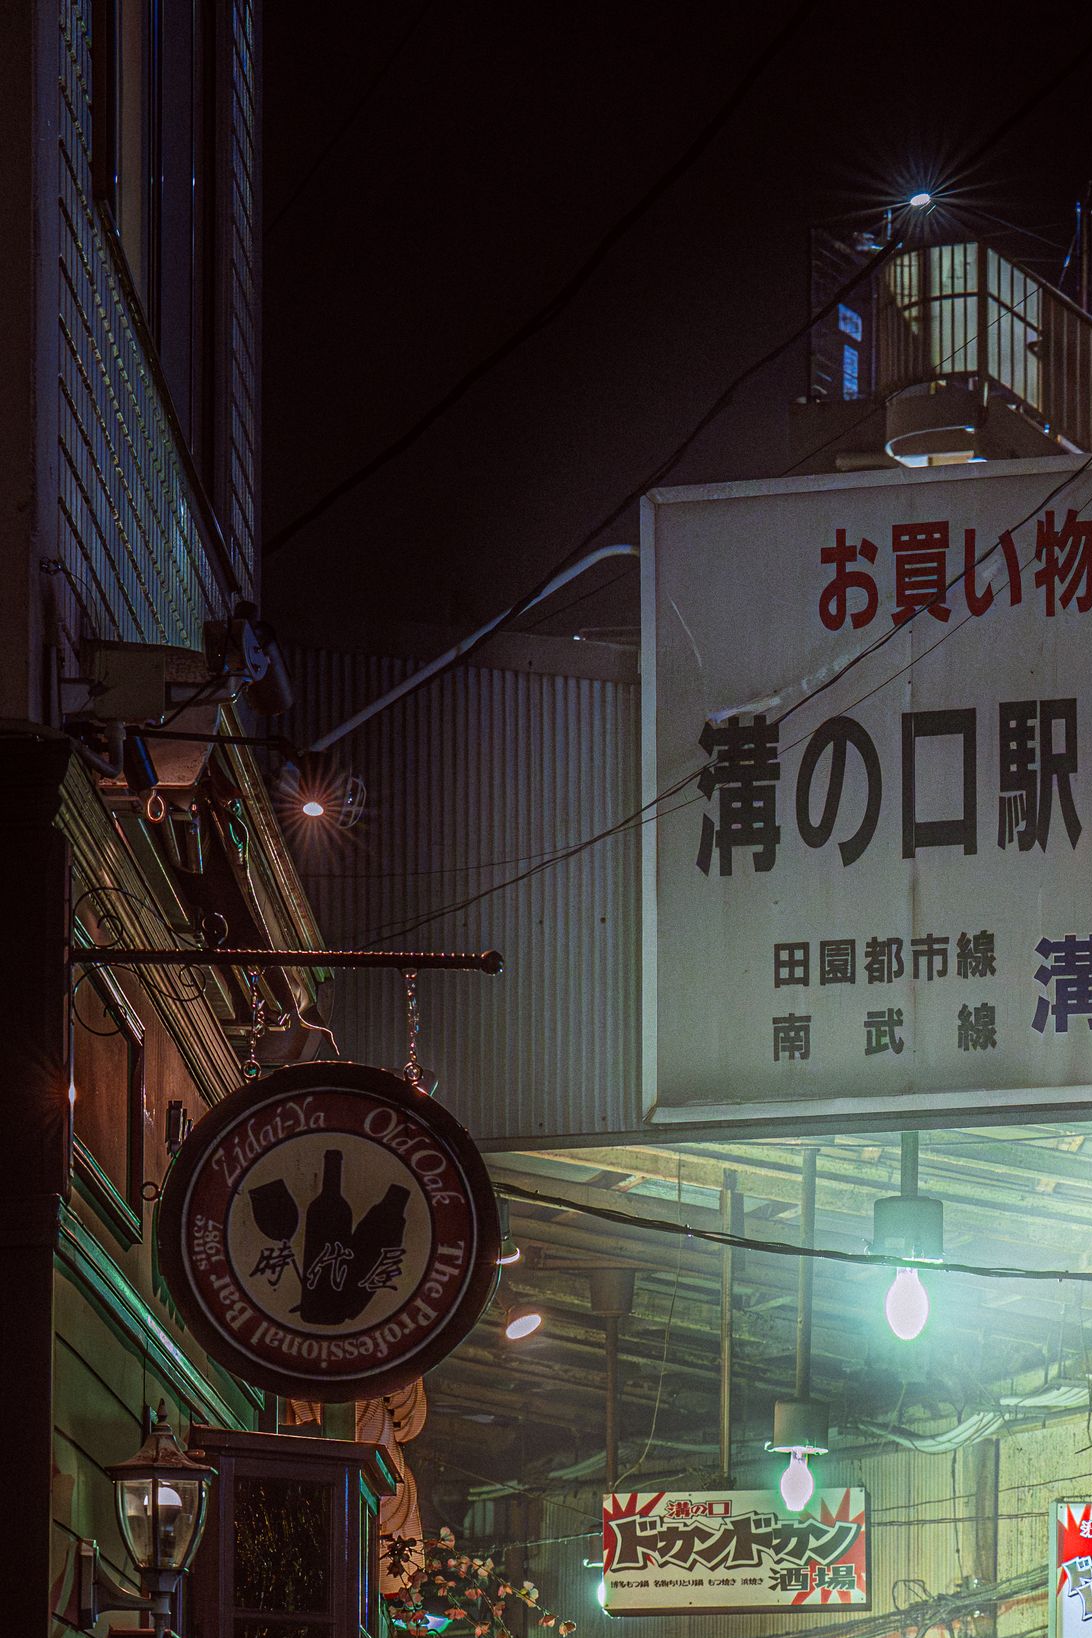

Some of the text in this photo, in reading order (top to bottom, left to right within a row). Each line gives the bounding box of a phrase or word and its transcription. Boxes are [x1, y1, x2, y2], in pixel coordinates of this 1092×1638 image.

[772, 928, 999, 990] 田園都市線
[363, 1106, 432, 1156] Old
[410, 1149, 466, 1207] Oak
[249, 1239, 407, 1293] 時代屋
[209, 1240, 466, 1369] The Professional Bar
[664, 1500, 733, 1520] 溝の口
[609, 1510, 862, 1573] ドカンドカン
[611, 1580, 650, 1589] 博多もつ鍋
[654, 1579, 704, 1588] 名物ちりとり鍋
[708, 1578, 737, 1586] もつ焼き
[768, 1562, 858, 1593] 酒場
